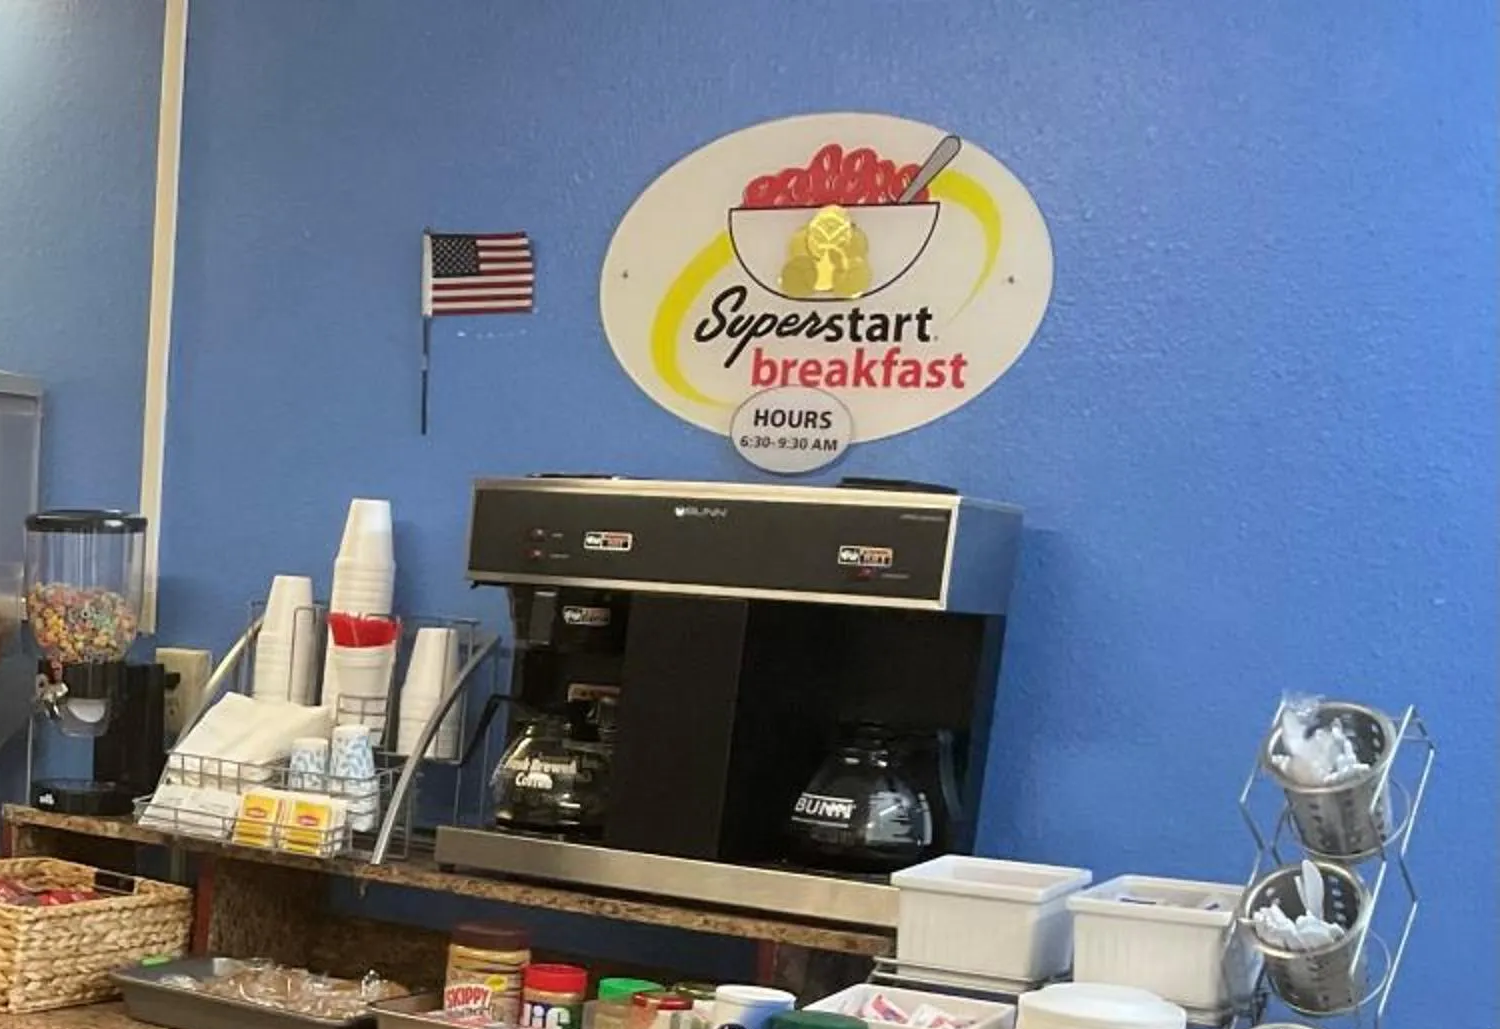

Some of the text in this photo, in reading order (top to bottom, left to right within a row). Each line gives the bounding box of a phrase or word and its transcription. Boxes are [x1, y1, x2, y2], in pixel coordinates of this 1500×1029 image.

[694, 285, 934, 368] Superstart
[750, 347, 969, 389] breakfast
[753, 408, 833, 430] HOURS
[810, 439, 839, 452] AM
[795, 797, 852, 819] BUNN
[446, 986, 487, 1008] SKIPPY
